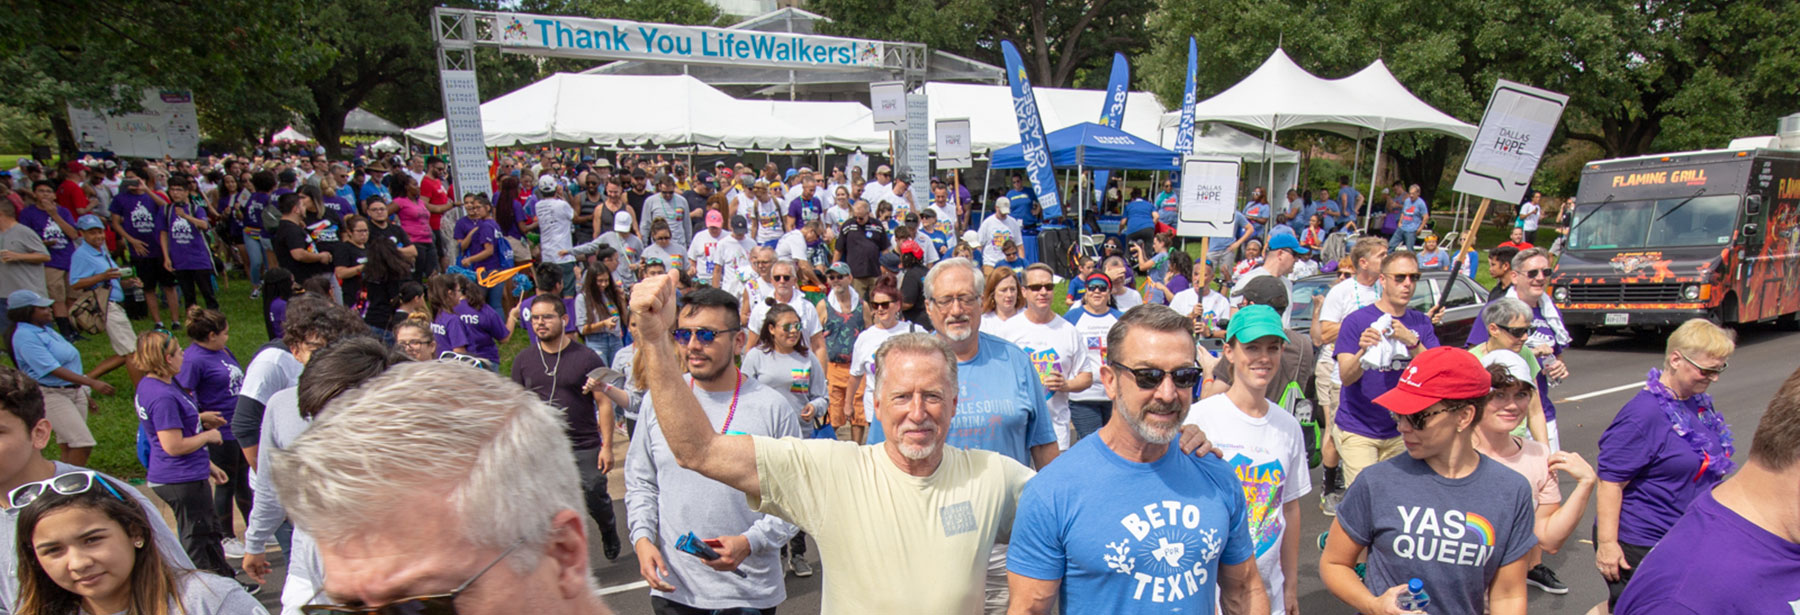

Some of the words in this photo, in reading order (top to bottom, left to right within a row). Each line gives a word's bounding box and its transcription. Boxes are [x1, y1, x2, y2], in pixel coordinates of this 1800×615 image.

[533, 19, 631, 51] Thank
[638, 27, 692, 56] You
[702, 31, 858, 65] LifeWalkers!
[1022, 81, 1048, 168] GLASSES
[1499, 127, 1531, 143] DALLAS
[1013, 97, 1042, 195] SAME-DAY
[1493, 136, 1527, 155] HOPE
[1612, 173, 1667, 188] FLAMING
[1670, 169, 1707, 183] GRILL
[1196, 191, 1221, 201] HOPE
[1235, 465, 1282, 486] ALLAS
[1120, 500, 1200, 542] BETO
[1396, 505, 1466, 539] YAS
[1164, 547, 1180, 557] POR
[1392, 534, 1495, 567] QUEEN
[1133, 561, 1208, 603] TEXAS
